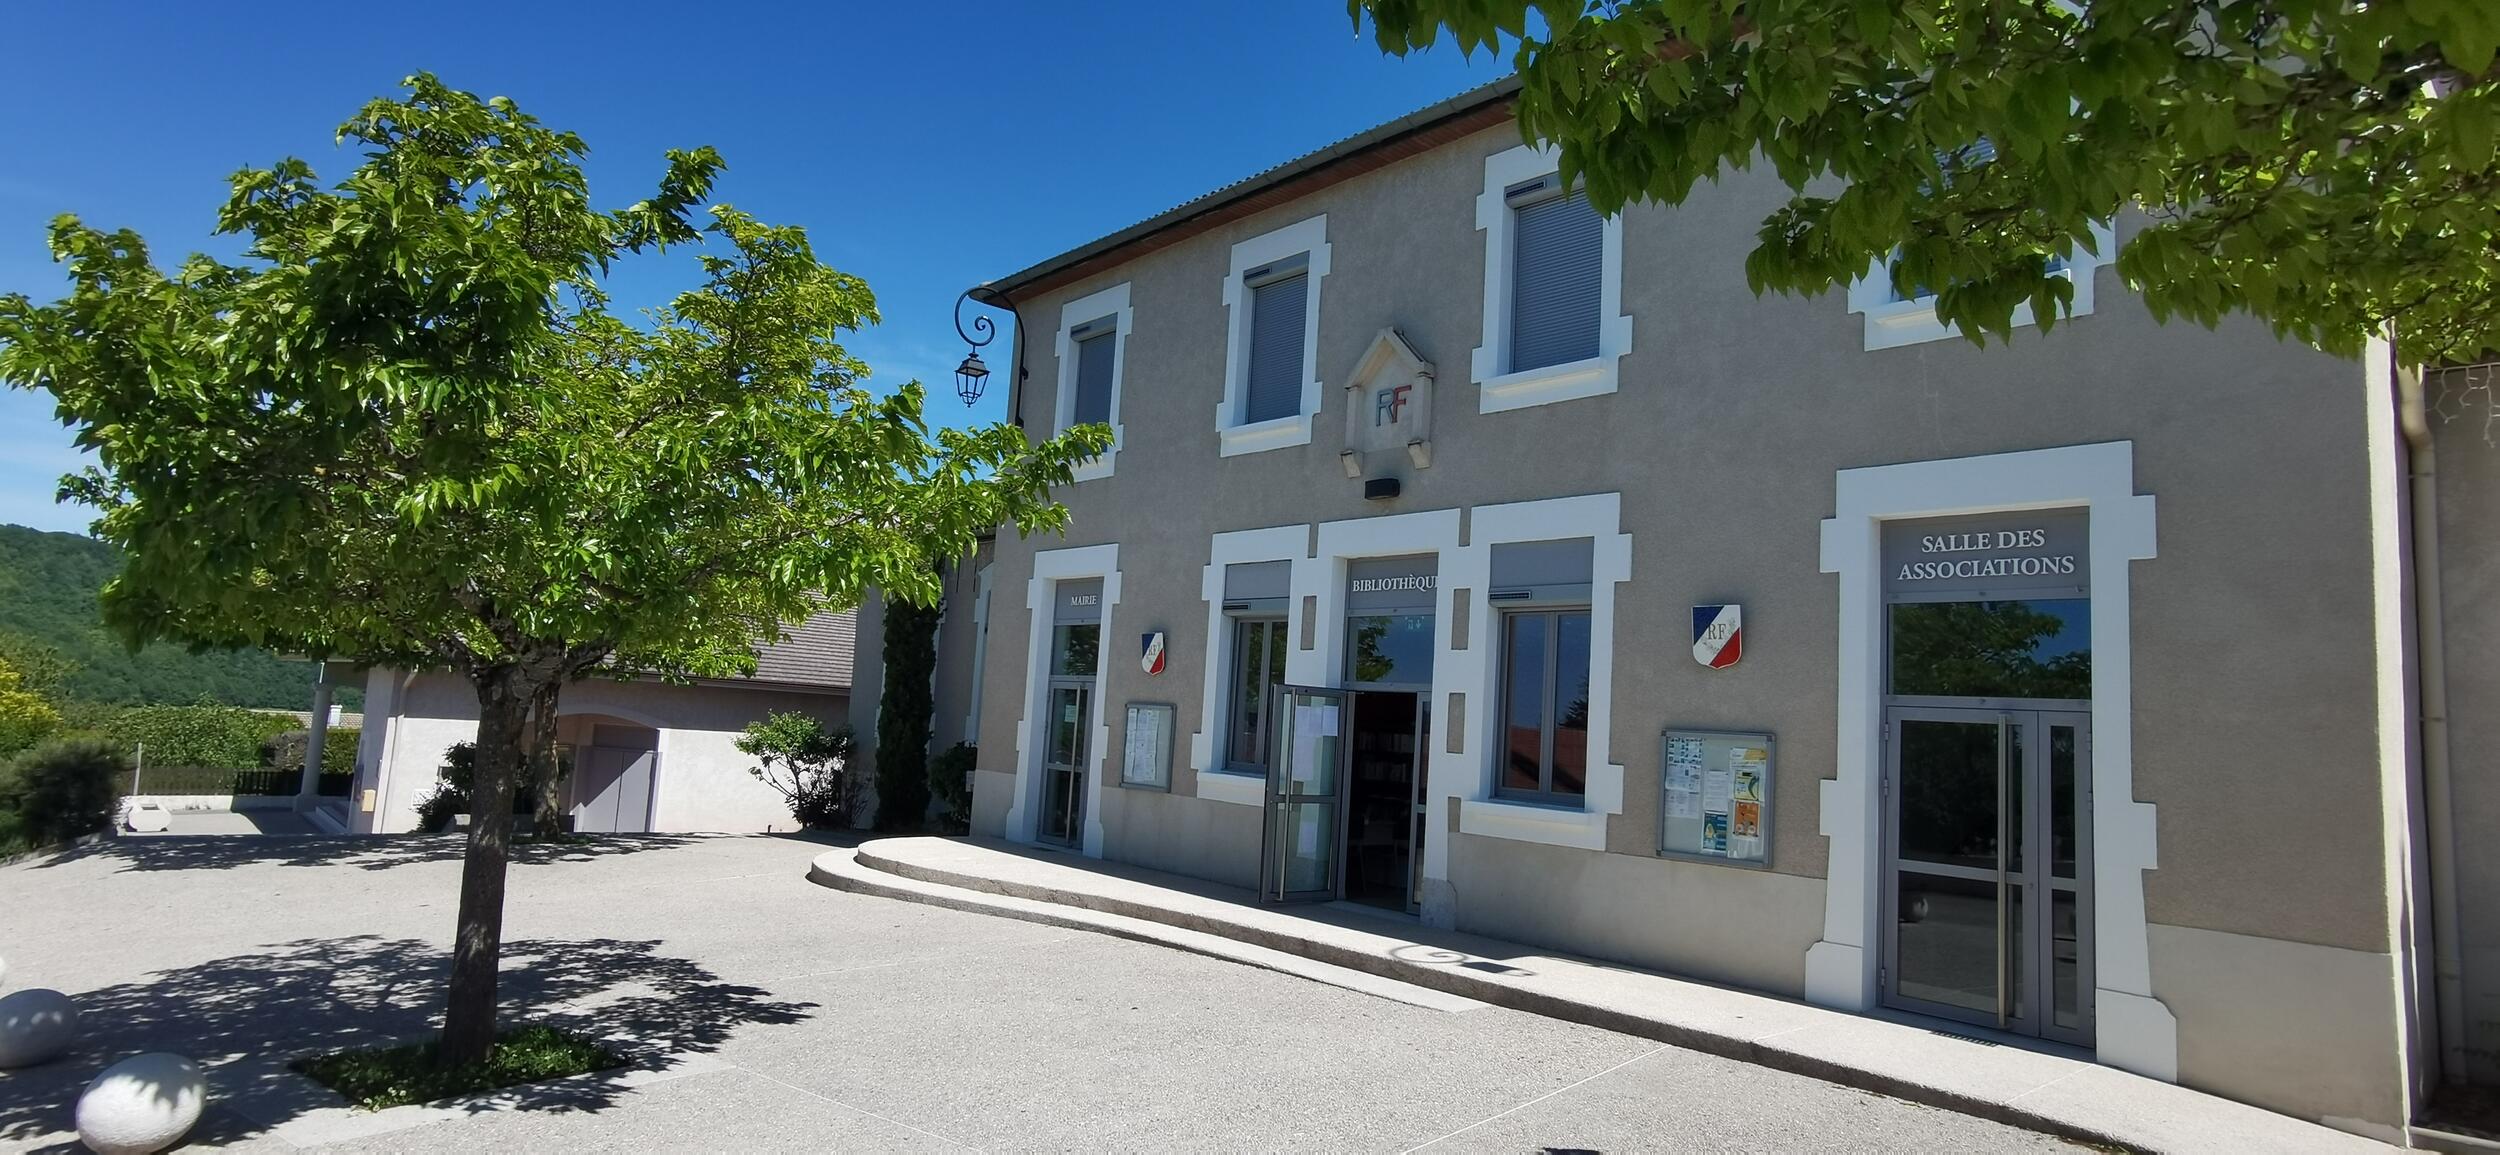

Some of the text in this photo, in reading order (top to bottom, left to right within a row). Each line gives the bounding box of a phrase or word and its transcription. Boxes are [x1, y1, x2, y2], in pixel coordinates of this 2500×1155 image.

[1375, 384, 1412, 427] RF
[1921, 529, 2046, 553] SALLE DES
[1897, 555, 2075, 580] ASSOCIATIONS
[1071, 595, 1097, 606] MAIRIE
[1707, 623, 1727, 640] RF
